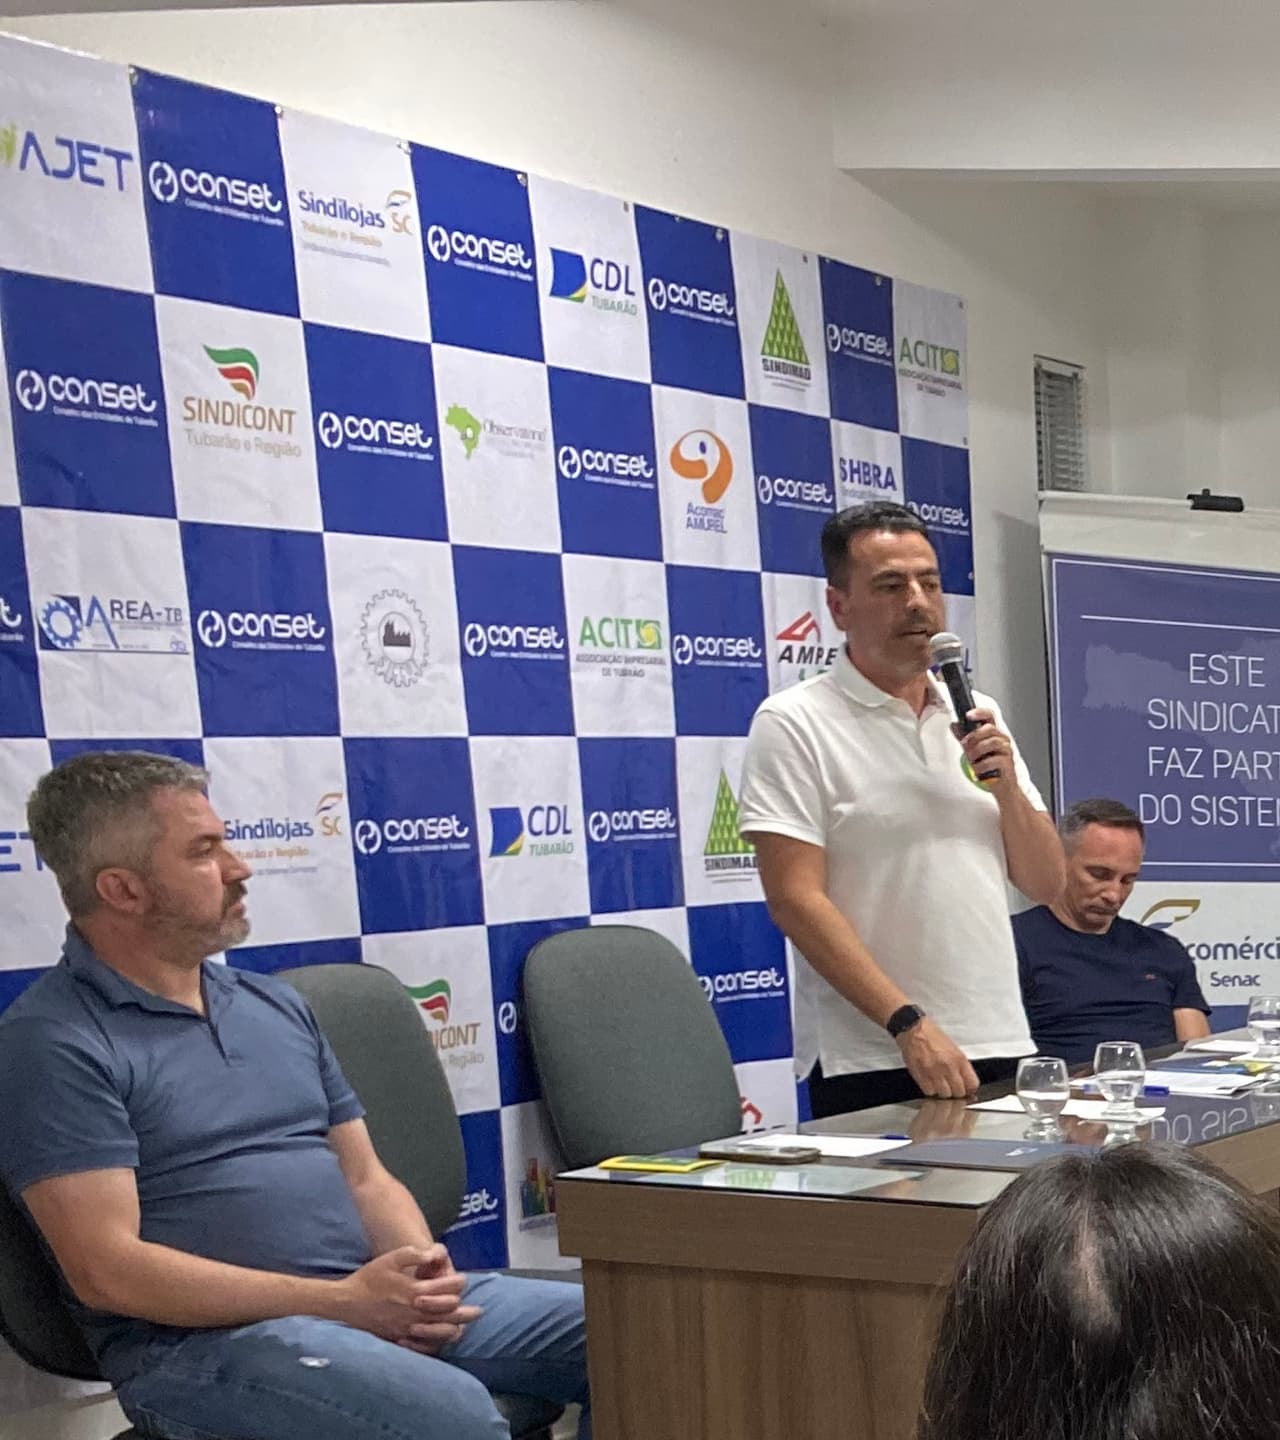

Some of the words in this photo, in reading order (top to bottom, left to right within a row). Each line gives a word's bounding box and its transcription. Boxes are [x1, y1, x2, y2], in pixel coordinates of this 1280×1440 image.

[19, 130, 133, 191] AJET
[181, 168, 282, 212] conset
[298, 189, 385, 228] Sindilojas
[391, 211, 414, 236] SC
[451, 231, 532, 269] conset
[590, 257, 635, 296] CDL
[668, 283, 734, 316] conset
[842, 328, 892, 357] conset
[48, 374, 157, 413] conset
[183, 396, 297, 434] SINDICONT
[344, 416, 433, 449] conset
[582, 449, 654, 478] conset
[774, 478, 832, 504] conset
[920, 504, 969, 527] conset
[228, 612, 326, 639] conset
[487, 624, 564, 649] conset
[579, 615, 634, 649] ACIT
[694, 636, 762, 659] conset
[777, 644, 839, 666] AMPE
[1189, 653, 1266, 687] ESTE
[1148, 747, 1204, 779] FAZ
[527, 804, 573, 836] CDL
[612, 807, 676, 831] conset
[1139, 793, 1182, 825] DO
[223, 817, 315, 841] Sindilojas
[384, 814, 469, 842] conset
[714, 967, 785, 993] conset
[1210, 971, 1261, 987] Senac
[431, 1022, 481, 1051] ICONT
